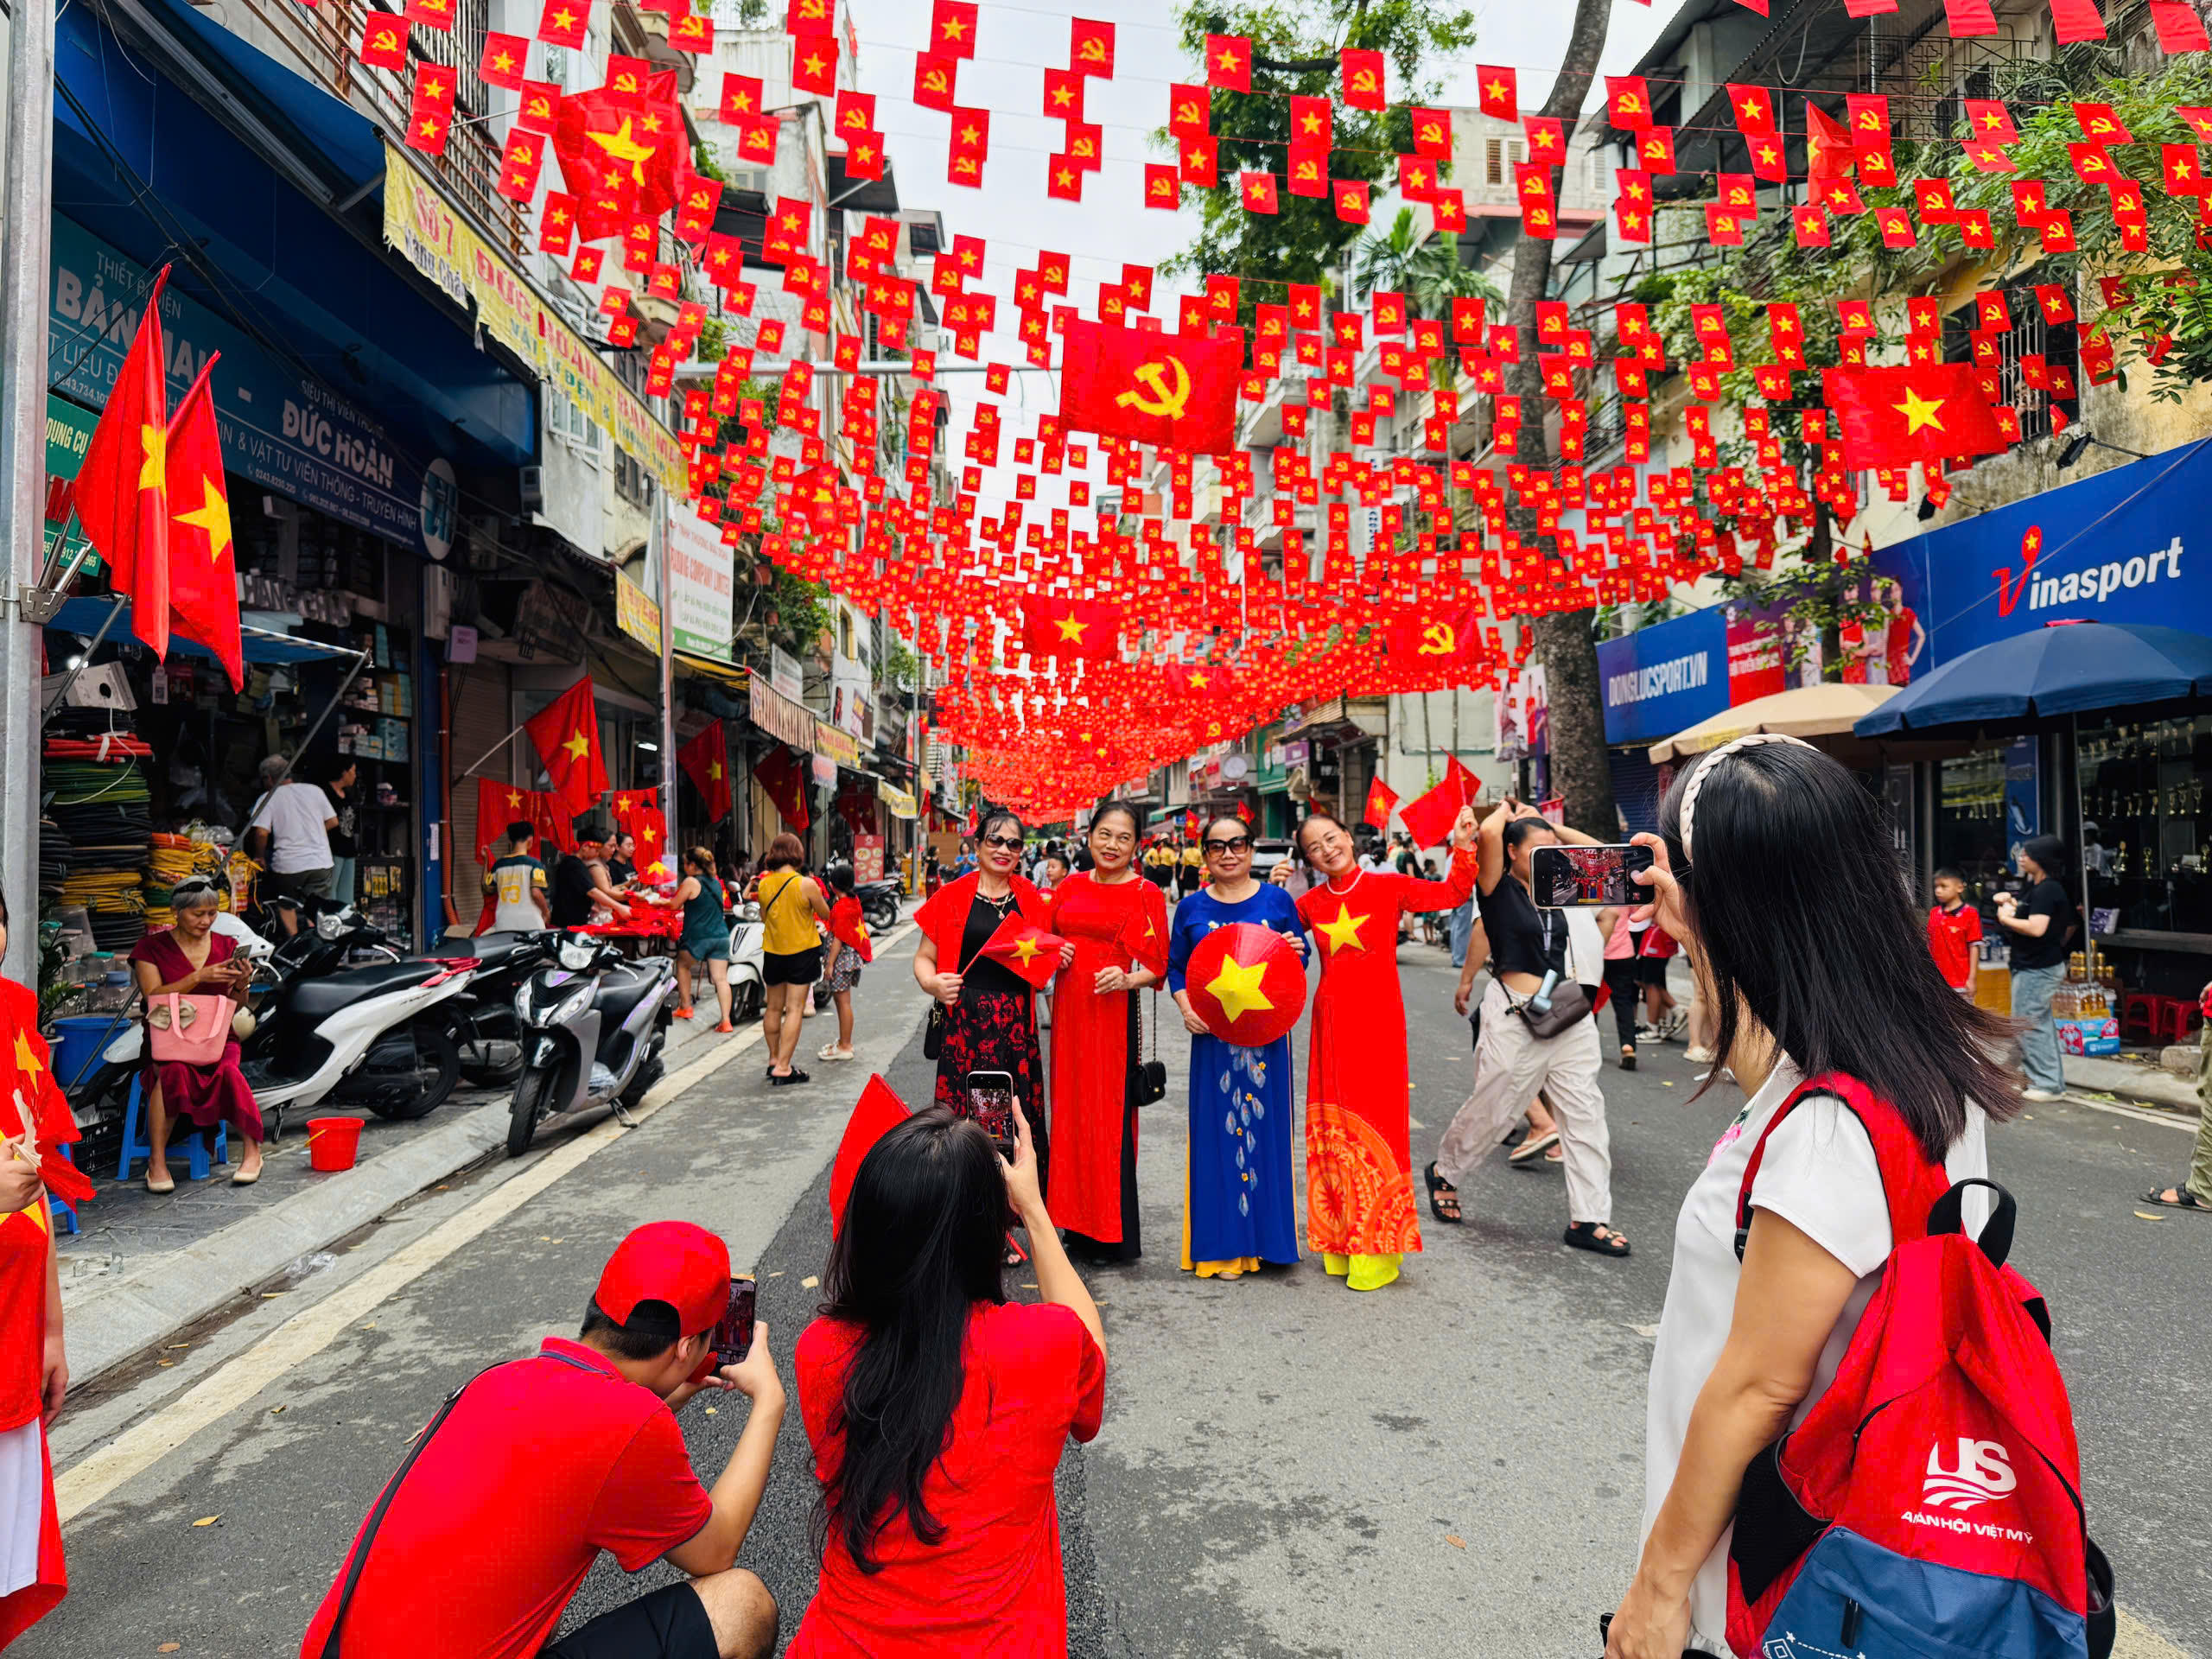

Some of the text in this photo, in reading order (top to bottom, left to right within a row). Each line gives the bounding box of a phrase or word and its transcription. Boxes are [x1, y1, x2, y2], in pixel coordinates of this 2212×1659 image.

[442, 213, 454, 256] 7
[97, 251, 134, 288] THIẾT
[160, 289, 181, 319] IỆN
[55, 265, 137, 351] BẢN
[283, 399, 333, 455] ĐỨC
[335, 430, 394, 489] HOÀN
[46, 416, 89, 459] DỤNG CỤ
[238, 431, 246, 451] &
[250, 435, 273, 464] VẬT
[276, 448, 292, 473] TƯ
[320, 472, 355, 502] THÔNG
[1992, 525, 2183, 617] Vinasport
[1926, 1437, 2018, 1493] US
[1941, 1517, 1970, 1535] HỘI
[1974, 1523, 2005, 1540] VIỆT
